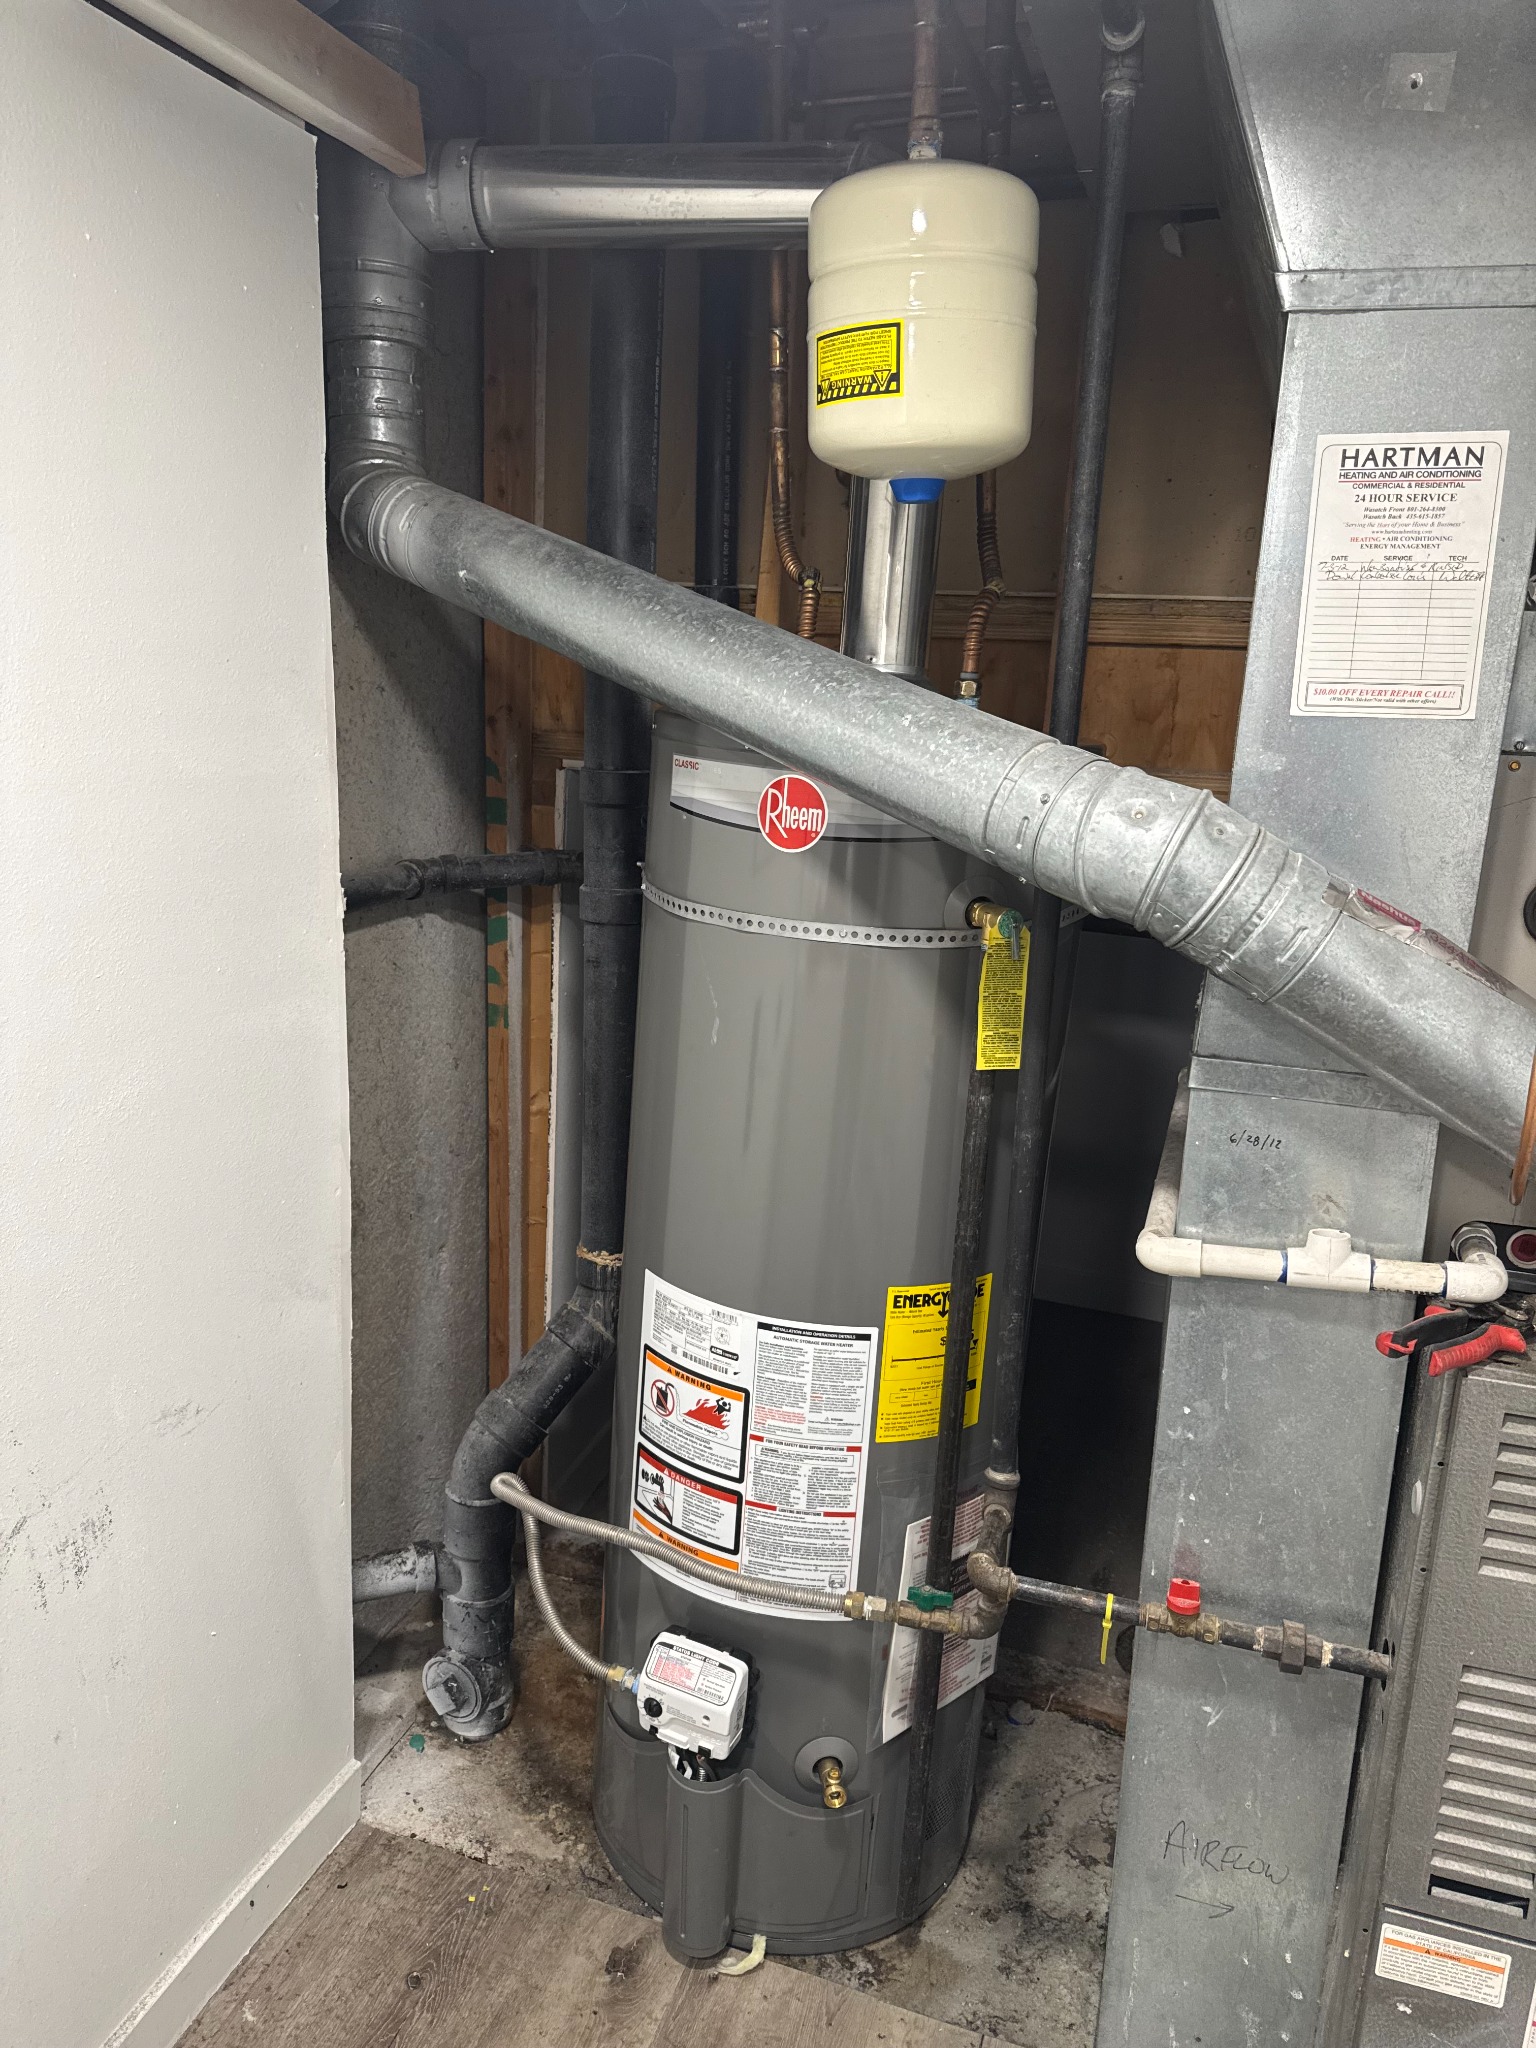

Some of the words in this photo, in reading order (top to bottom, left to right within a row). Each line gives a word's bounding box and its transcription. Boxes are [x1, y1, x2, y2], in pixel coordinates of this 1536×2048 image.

[832, 376, 872, 389] WARNING
[1340, 446, 1485, 468] HARTMAN
[1416, 470, 1482, 478] CONDITIONING
[1355, 494, 1365, 502] 24
[1369, 494, 1403, 502] HOUR
[1406, 493, 1457, 502] SERVICE
[1390, 690, 1422, 698] REPAIR
[674, 758, 699, 770] CLASSIC
[766, 778, 823, 838] Rheem
[1230, 1130, 1282, 1150] 6/28/12
[674, 1370, 711, 1390] WARNING
[670, 1471, 702, 1491] DANGER
[668, 1537, 699, 1556] WARNING
[673, 1645, 690, 1656] STATUS
[1164, 1820, 1289, 1884] AIRFLOW
[1417, 1937, 1451, 1948] APPLIANCES
[1435, 1952, 1460, 1962] WARNING
